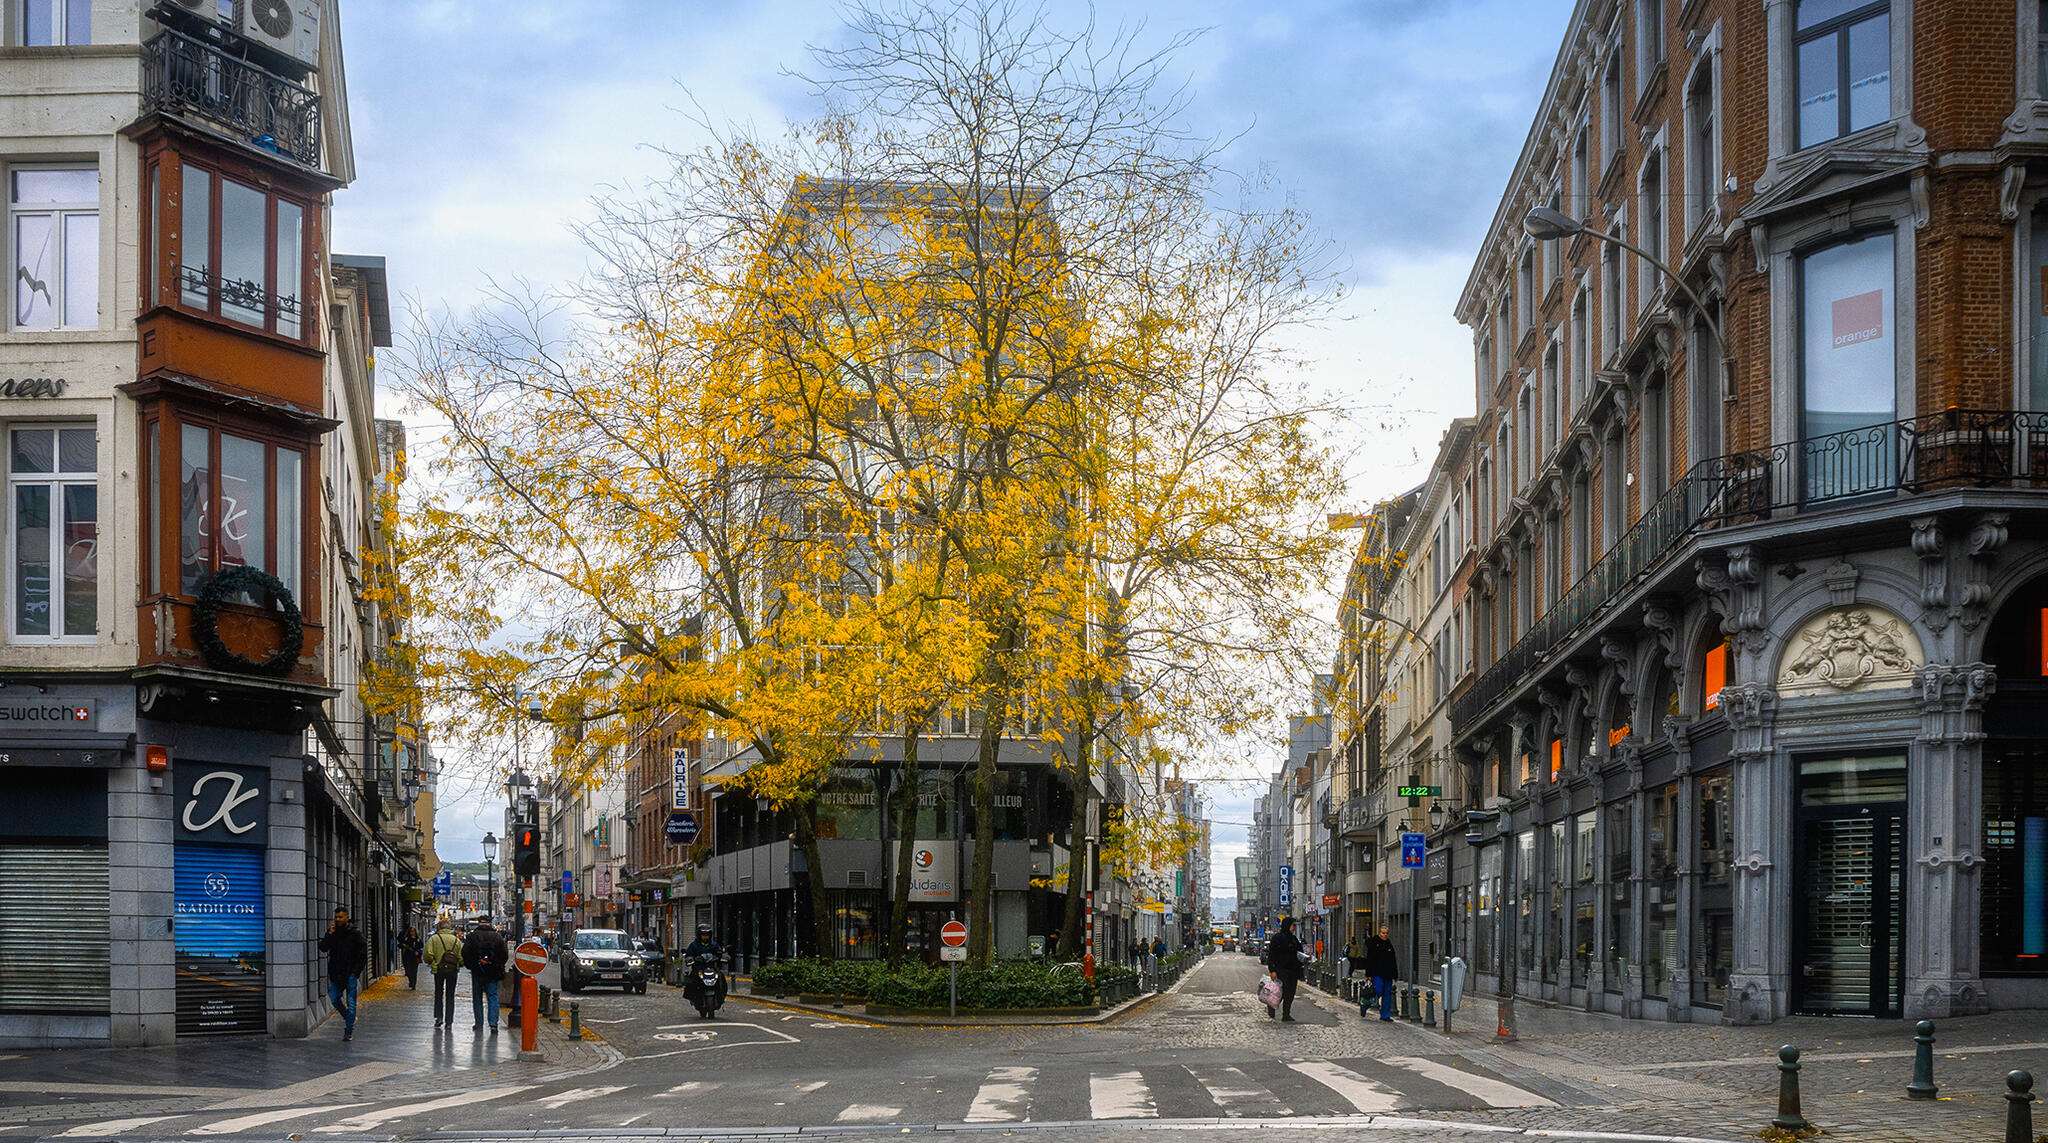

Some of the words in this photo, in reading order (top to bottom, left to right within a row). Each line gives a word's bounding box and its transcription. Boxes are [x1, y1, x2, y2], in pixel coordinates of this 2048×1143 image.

[1834, 327, 1878, 345] orange
[0, 704, 74, 721] swatch
[674, 750, 687, 807] MAURICE
[820, 791, 847, 805] VOTRE
[848, 790, 876, 806] SANTÉ
[1399, 786, 1428, 797] 12:22
[993, 795, 1023, 808] ILLEUR
[208, 878, 226, 893] 55
[908, 879, 952, 890] olidaris
